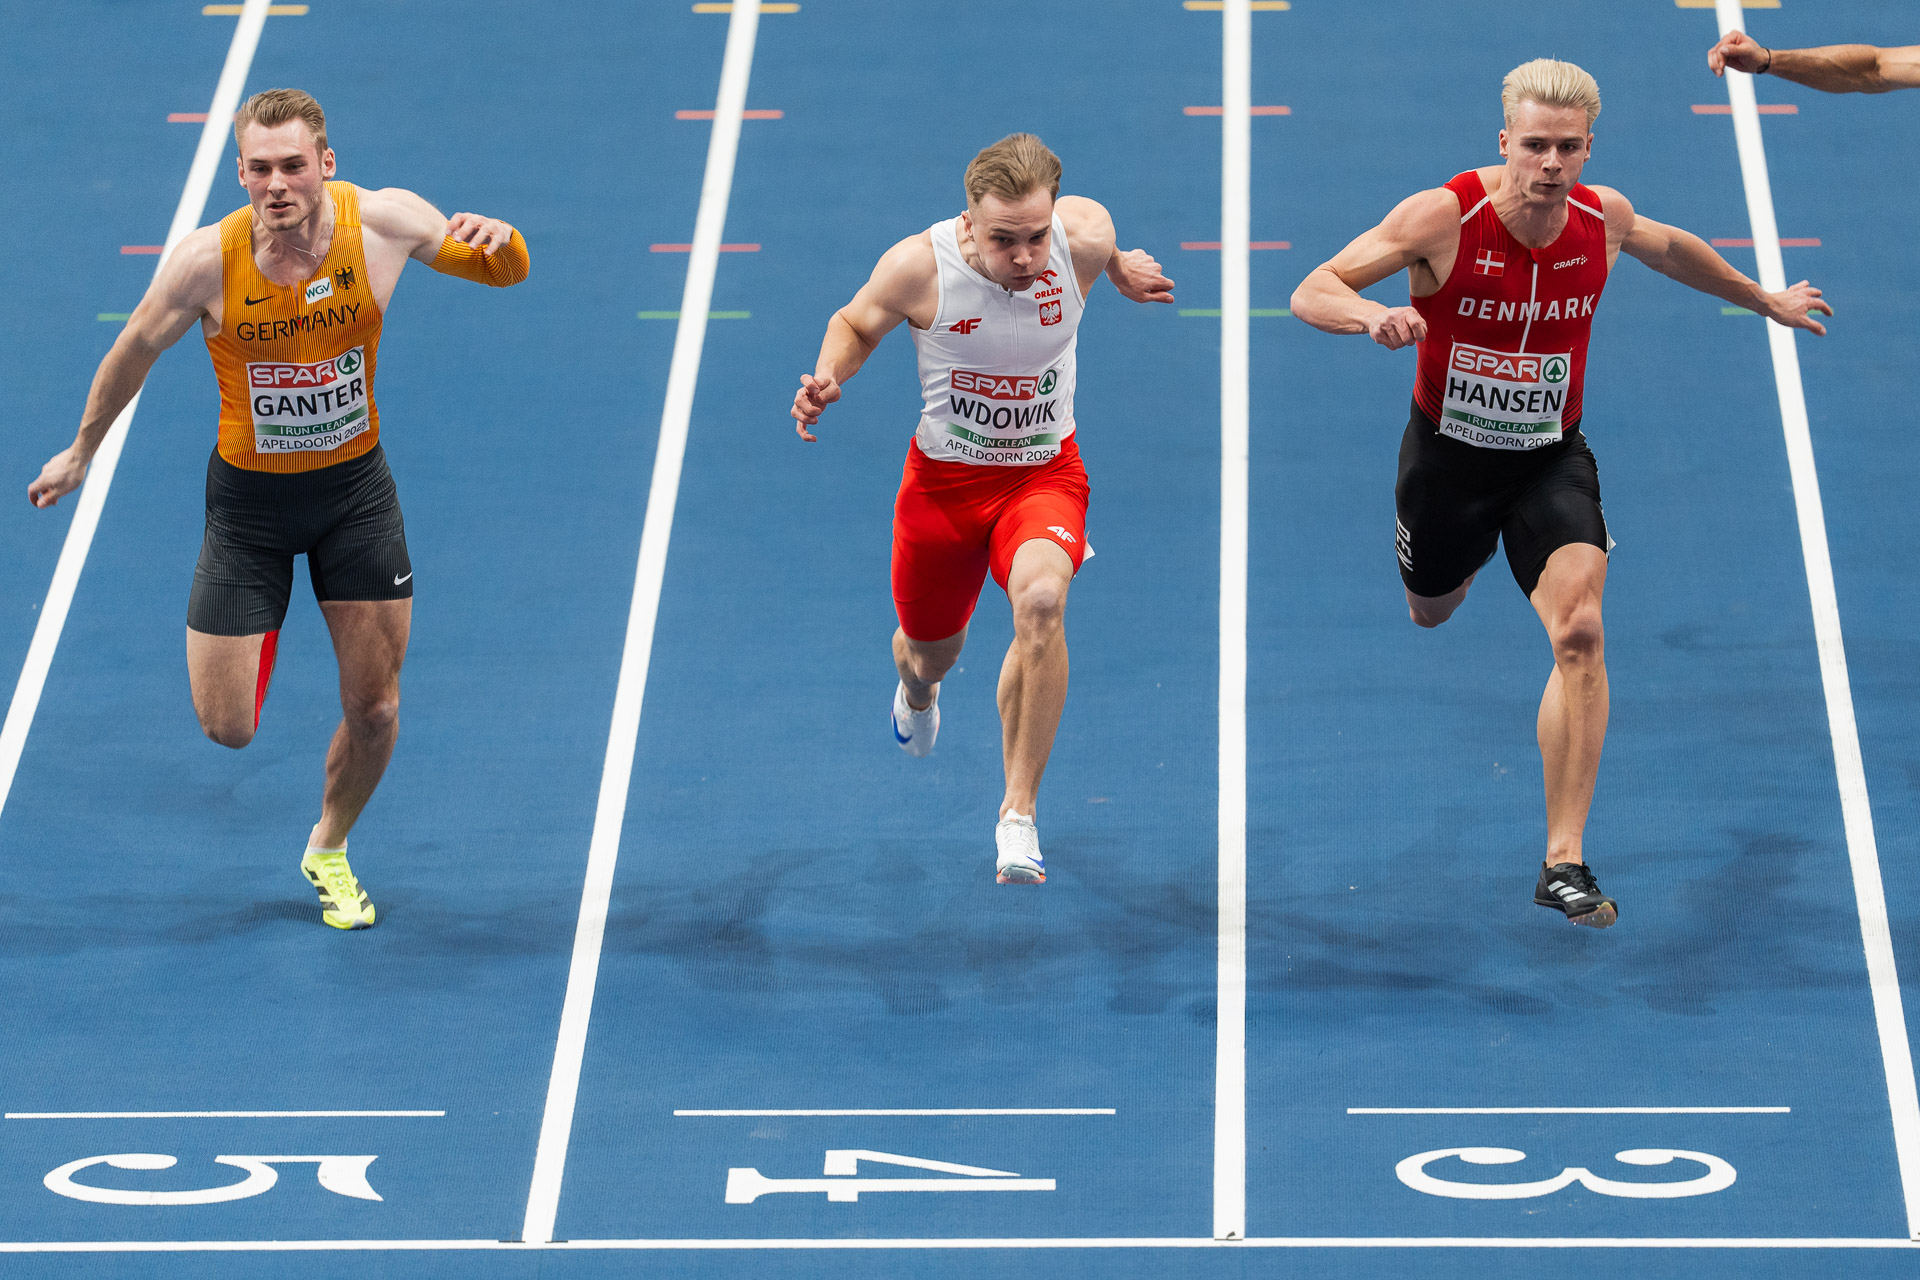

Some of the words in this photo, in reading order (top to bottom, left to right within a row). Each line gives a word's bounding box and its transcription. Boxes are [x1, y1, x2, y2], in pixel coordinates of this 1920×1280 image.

[1553, 257, 1582, 270] CRAFT
[306, 281, 331, 299] WGV
[1034, 286, 1063, 300] ORLEN
[1457, 293, 1596, 322] DENMARK
[237, 302, 361, 342] GERMANY
[948, 318, 982, 335] 4F
[252, 362, 335, 385] SPAR
[1454, 350, 1539, 380] SPAR
[253, 377, 364, 417] GANTER
[954, 373, 1037, 397] SPAR
[1448, 376, 1563, 414] HANSEN
[949, 394, 1057, 430] WDOWIK
[1472, 416, 1496, 429] RUN
[261, 432, 342, 450] APELDOORN
[344, 418, 368, 440] 2025
[285, 425, 310, 436] RUN
[972, 433, 994, 447] RUN
[1444, 422, 1525, 448] APELDOORN
[945, 438, 1023, 463] APELDOORN
[1026, 449, 1056, 462] 2025
[1046, 525, 1077, 544] 4F
[43, 1153, 386, 1206] 5
[725, 1150, 1058, 1206] 4
[1395, 1147, 1739, 1201] 3
